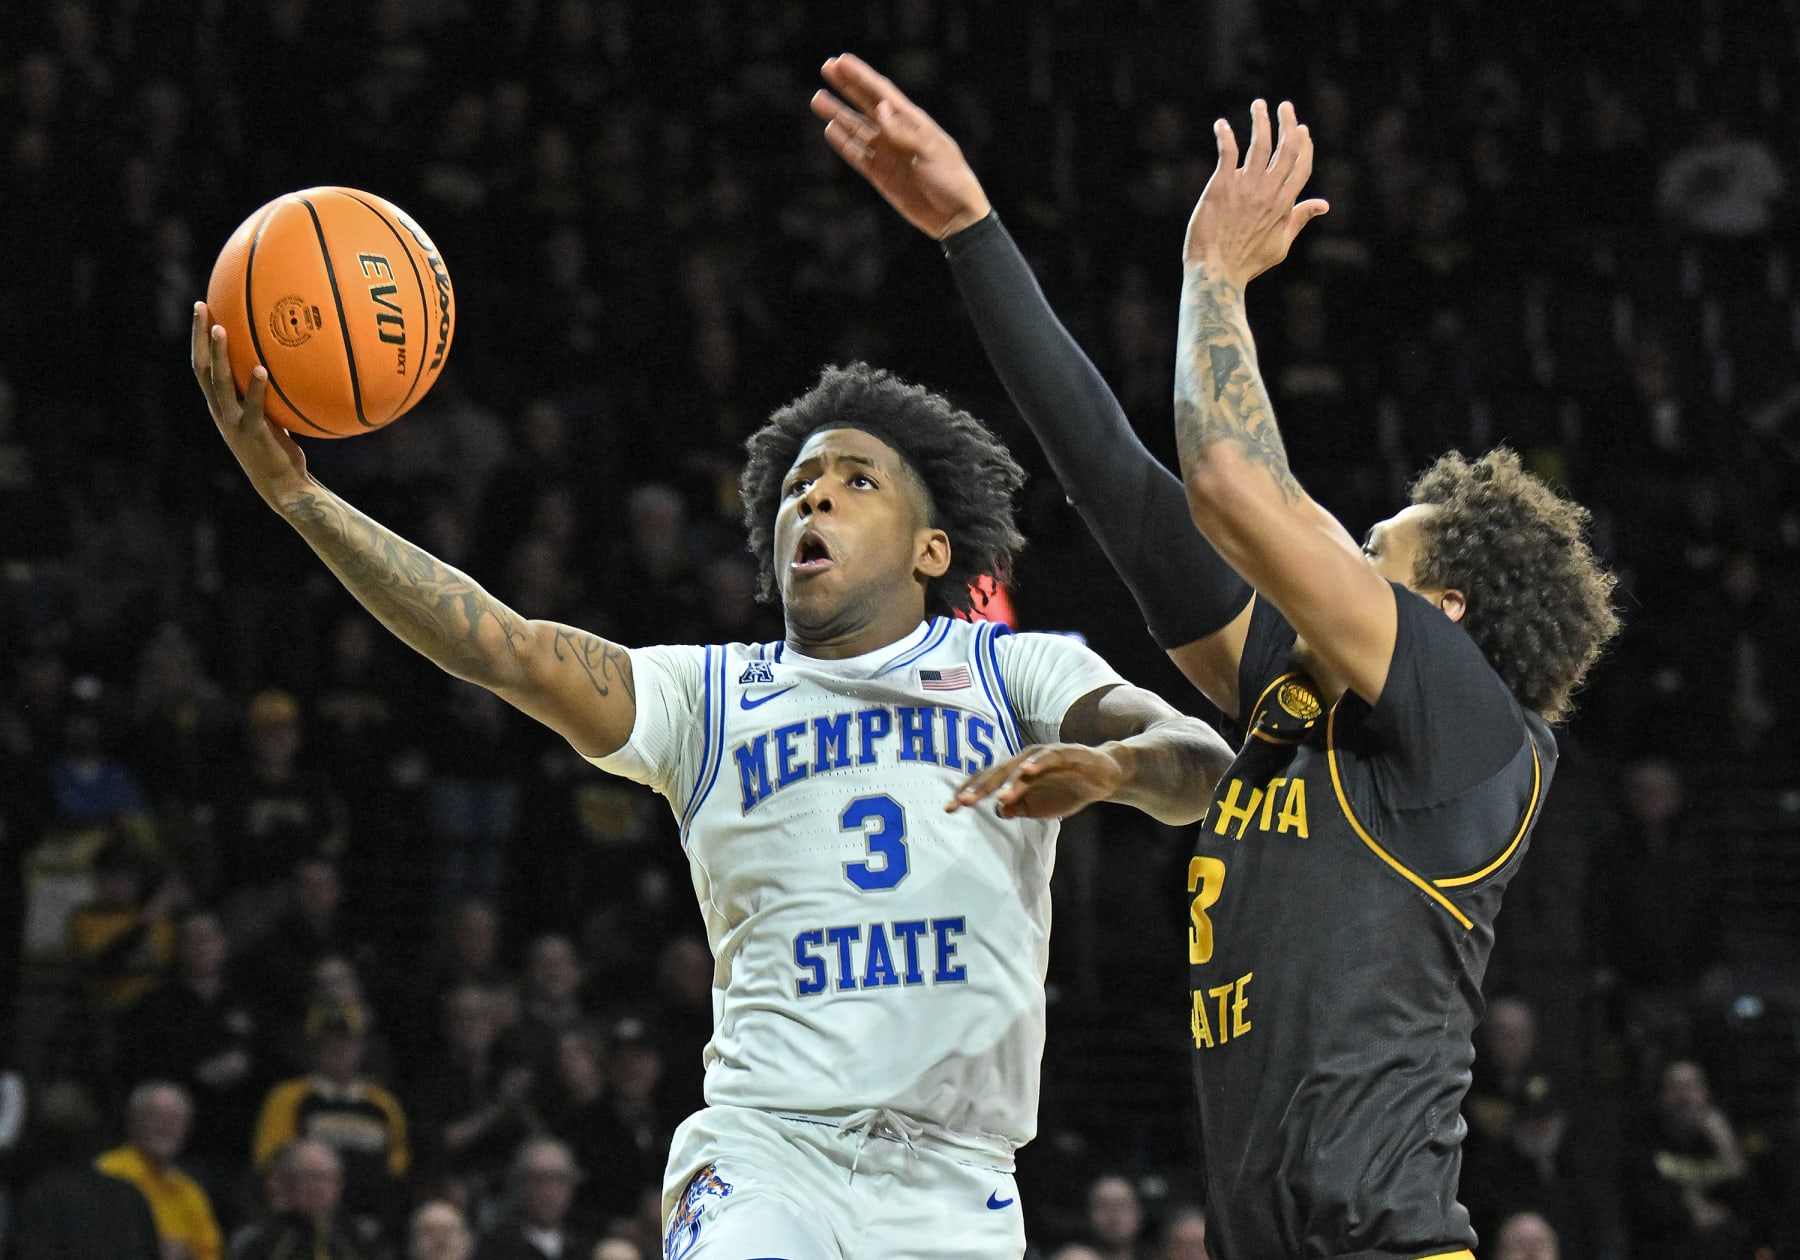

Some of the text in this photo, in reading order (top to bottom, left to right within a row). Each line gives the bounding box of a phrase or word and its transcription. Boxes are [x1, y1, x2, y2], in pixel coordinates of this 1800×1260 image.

[357, 252, 406, 346] EVO
[732, 705, 996, 818] MEMPHIS
[838, 793, 912, 893] 3
[793, 915, 968, 999] STATE
[1189, 971, 1253, 1050] ATE
